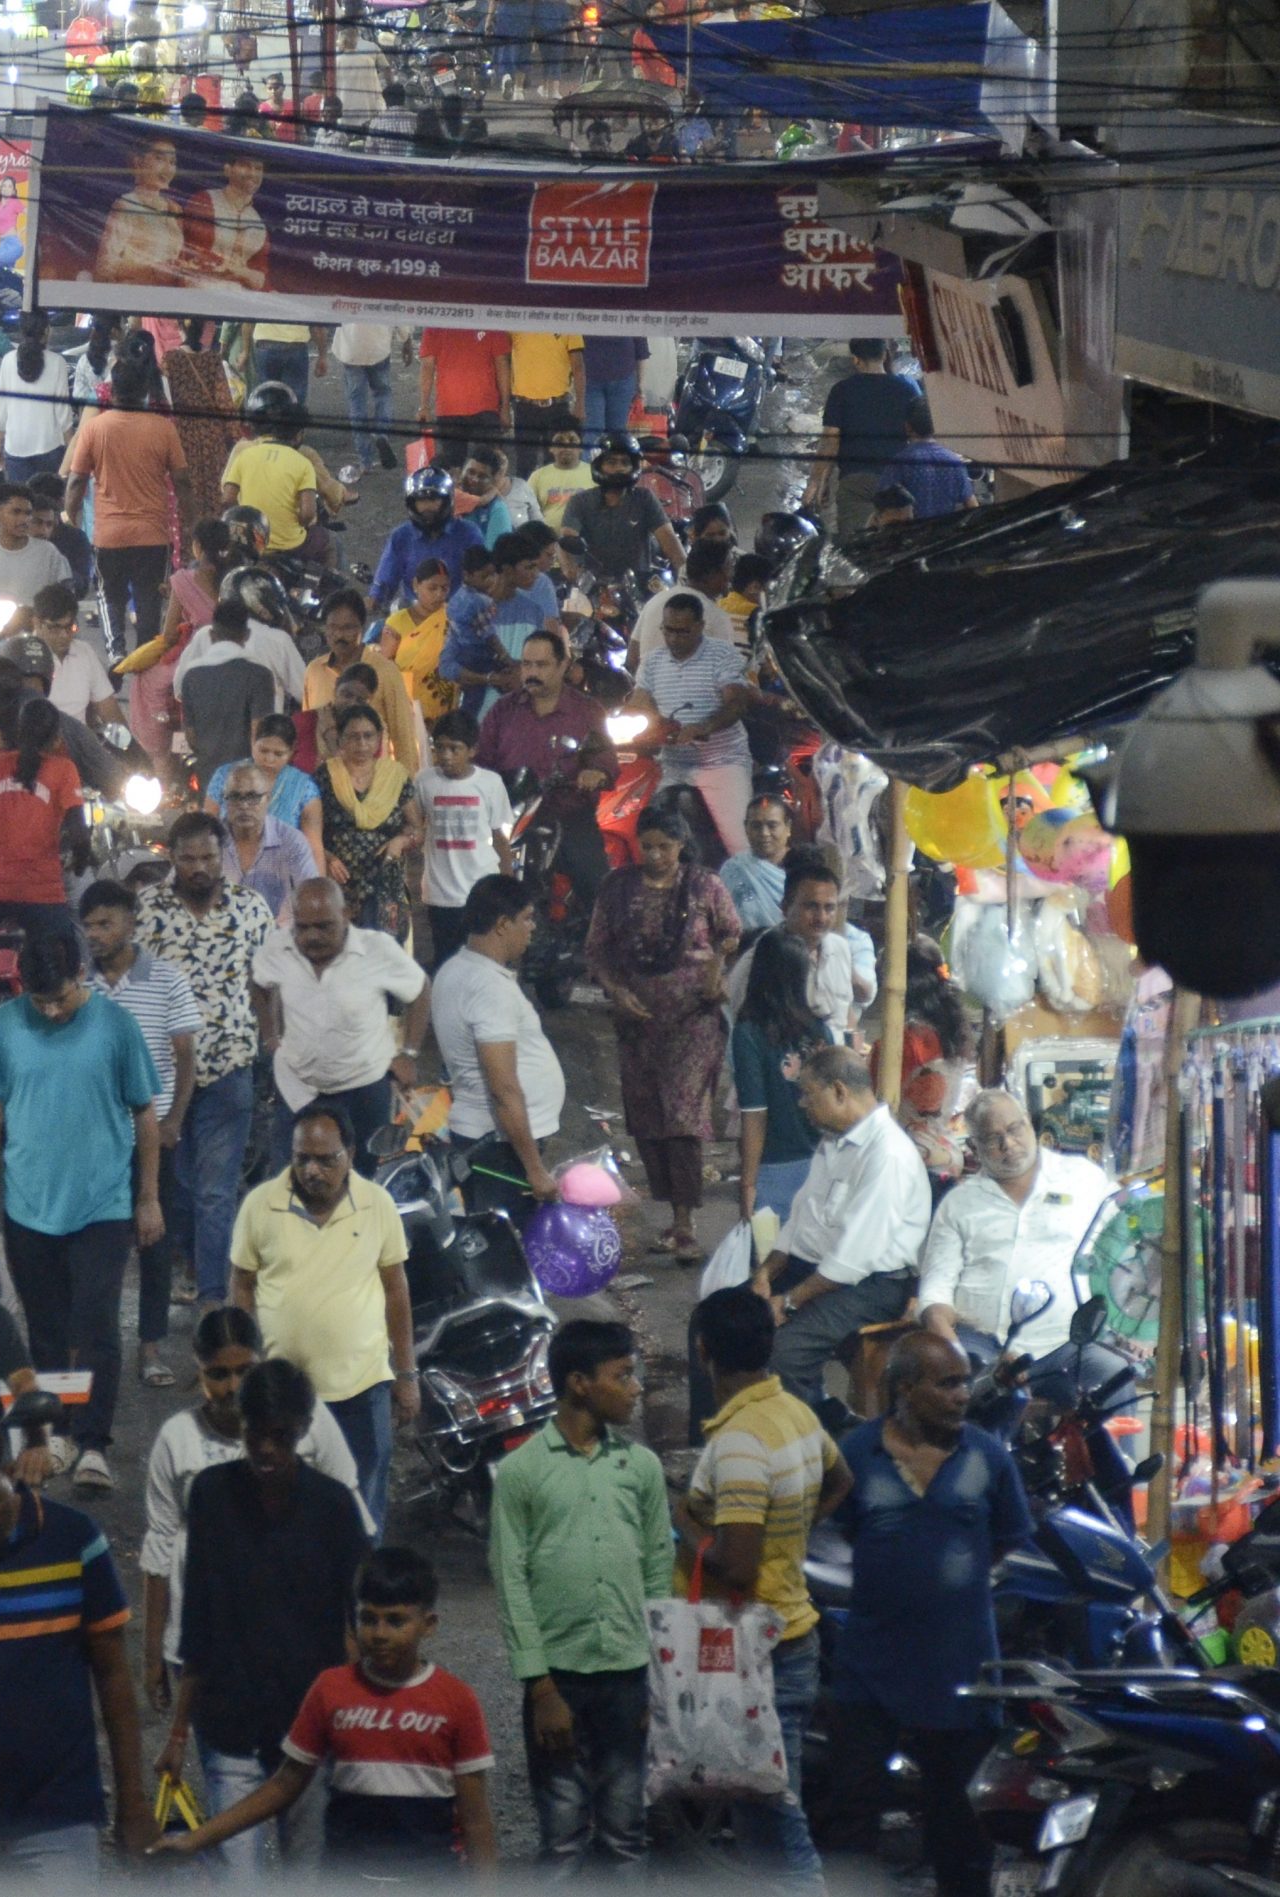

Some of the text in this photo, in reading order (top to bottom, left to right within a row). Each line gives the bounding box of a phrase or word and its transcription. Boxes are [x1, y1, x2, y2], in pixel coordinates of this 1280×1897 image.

[539, 216, 641, 246] STYLE
[534, 247, 639, 270] BAAZAR
[416, 305, 475, 319] 9147372813
[333, 1705, 449, 1735] CHILL OUT
